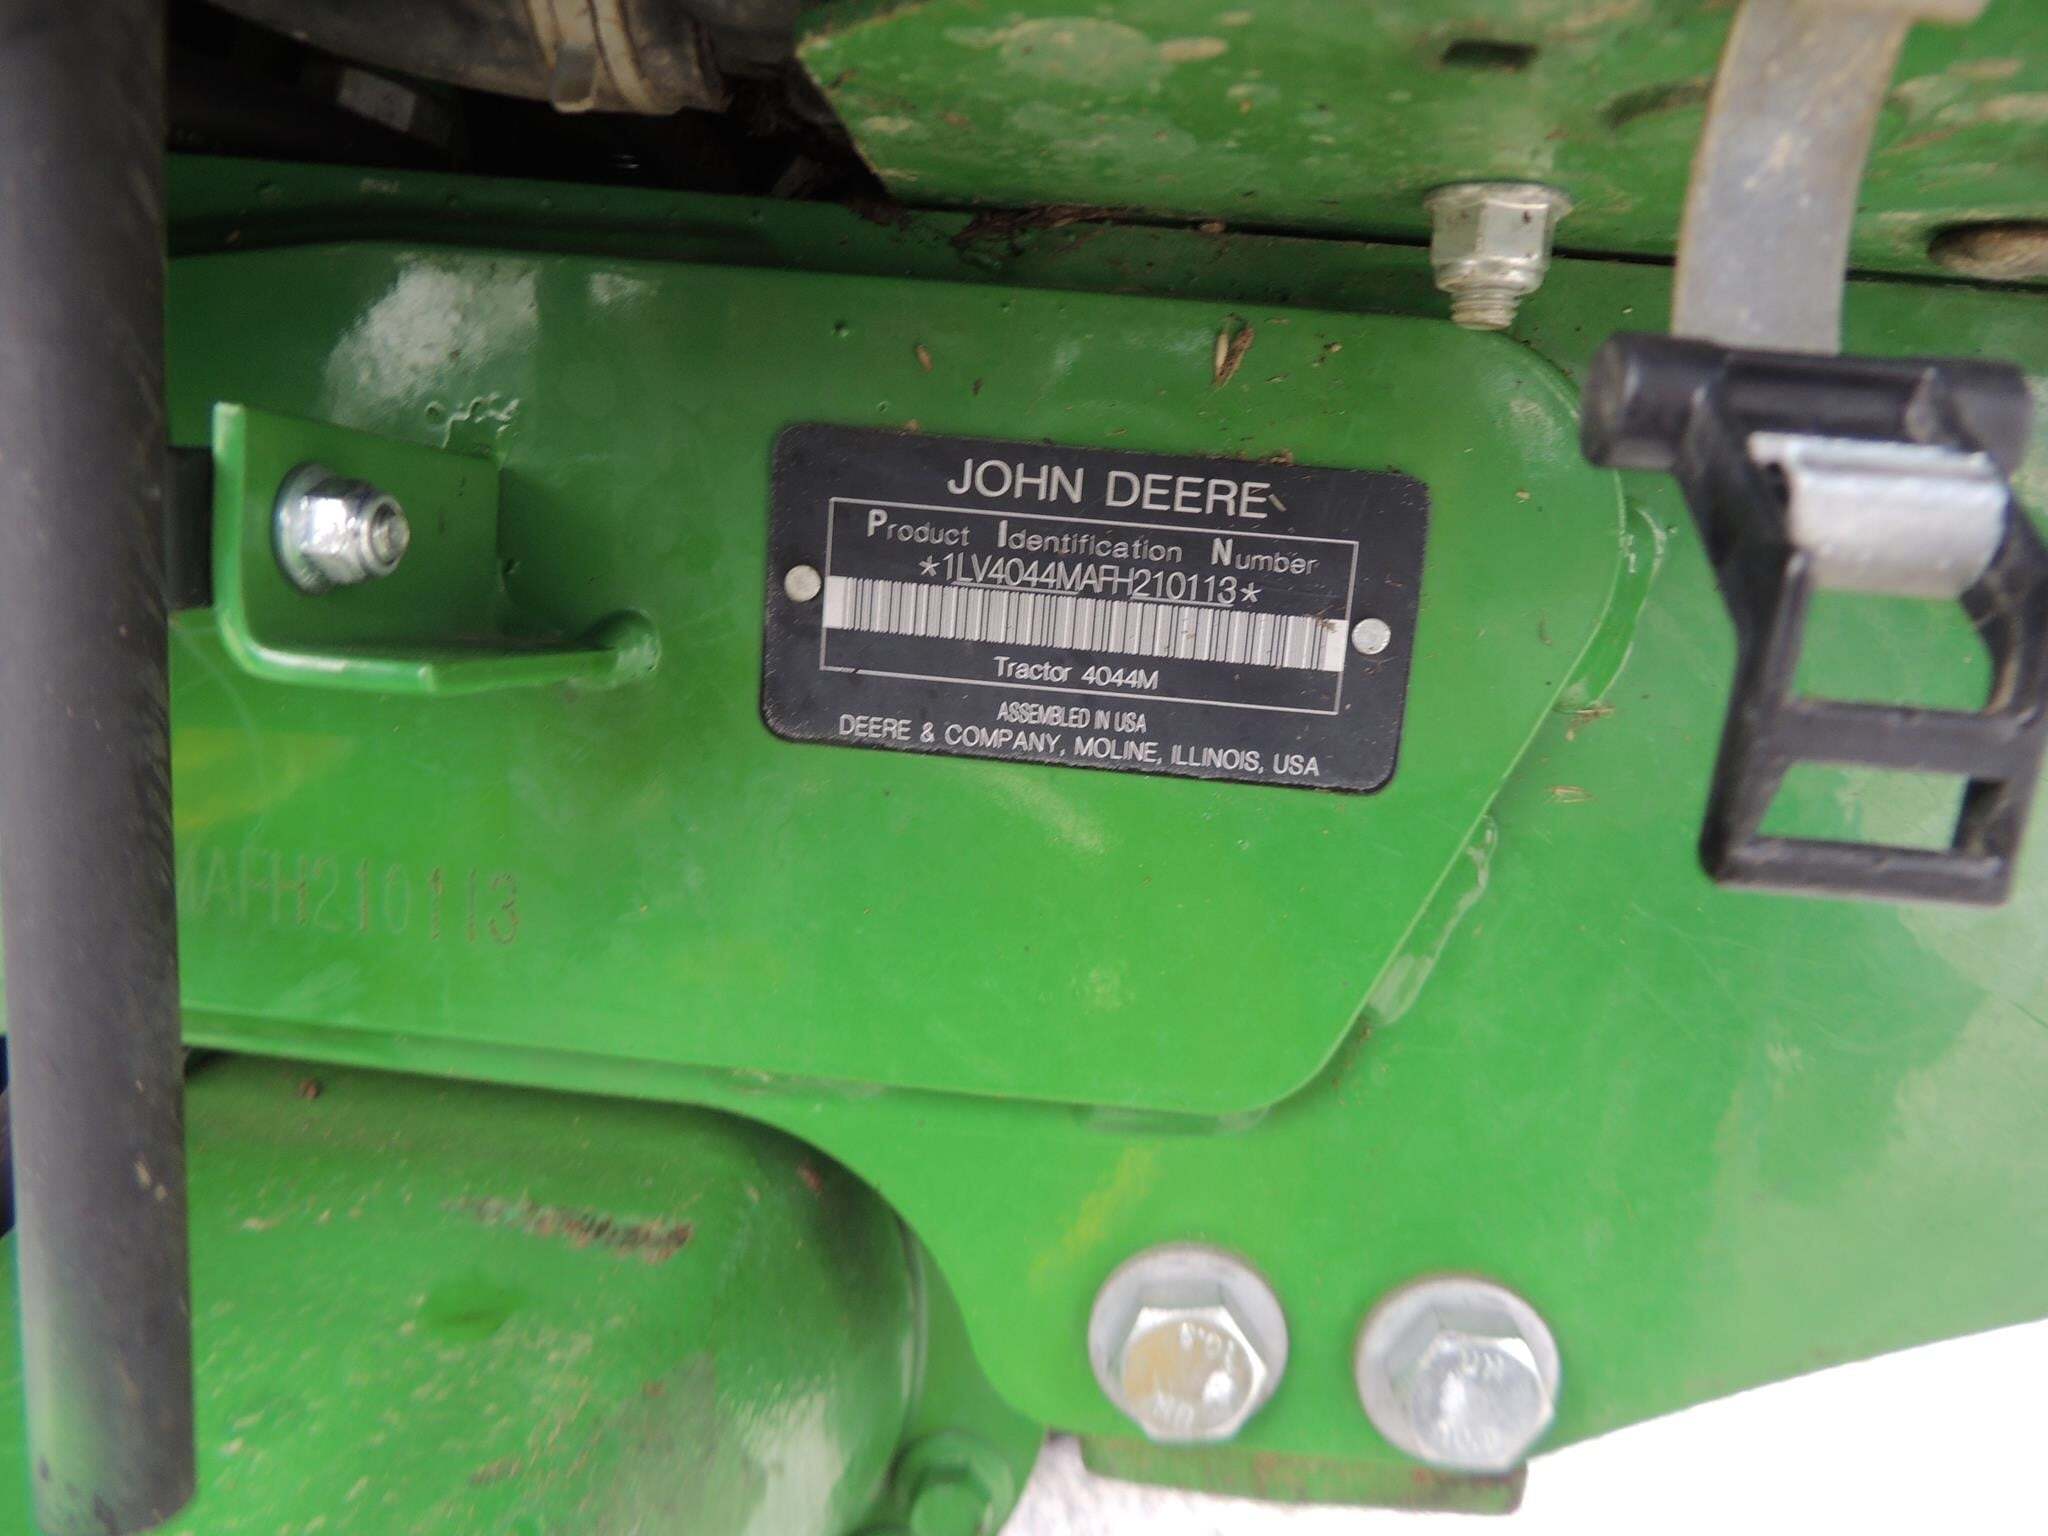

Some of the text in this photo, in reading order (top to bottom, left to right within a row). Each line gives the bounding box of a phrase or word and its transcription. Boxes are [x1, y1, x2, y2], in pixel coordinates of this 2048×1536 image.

[947, 458, 1271, 519] JOHN DEERE
[866, 508, 1320, 575] Product Identification Number
[993, 656, 1159, 690] Tractor 4044M
[838, 713, 1320, 777] DEERE & COMPANY, MOLINE, ILLINOIS, USA
[996, 701, 1147, 734] ASSEMBLED IN USA
